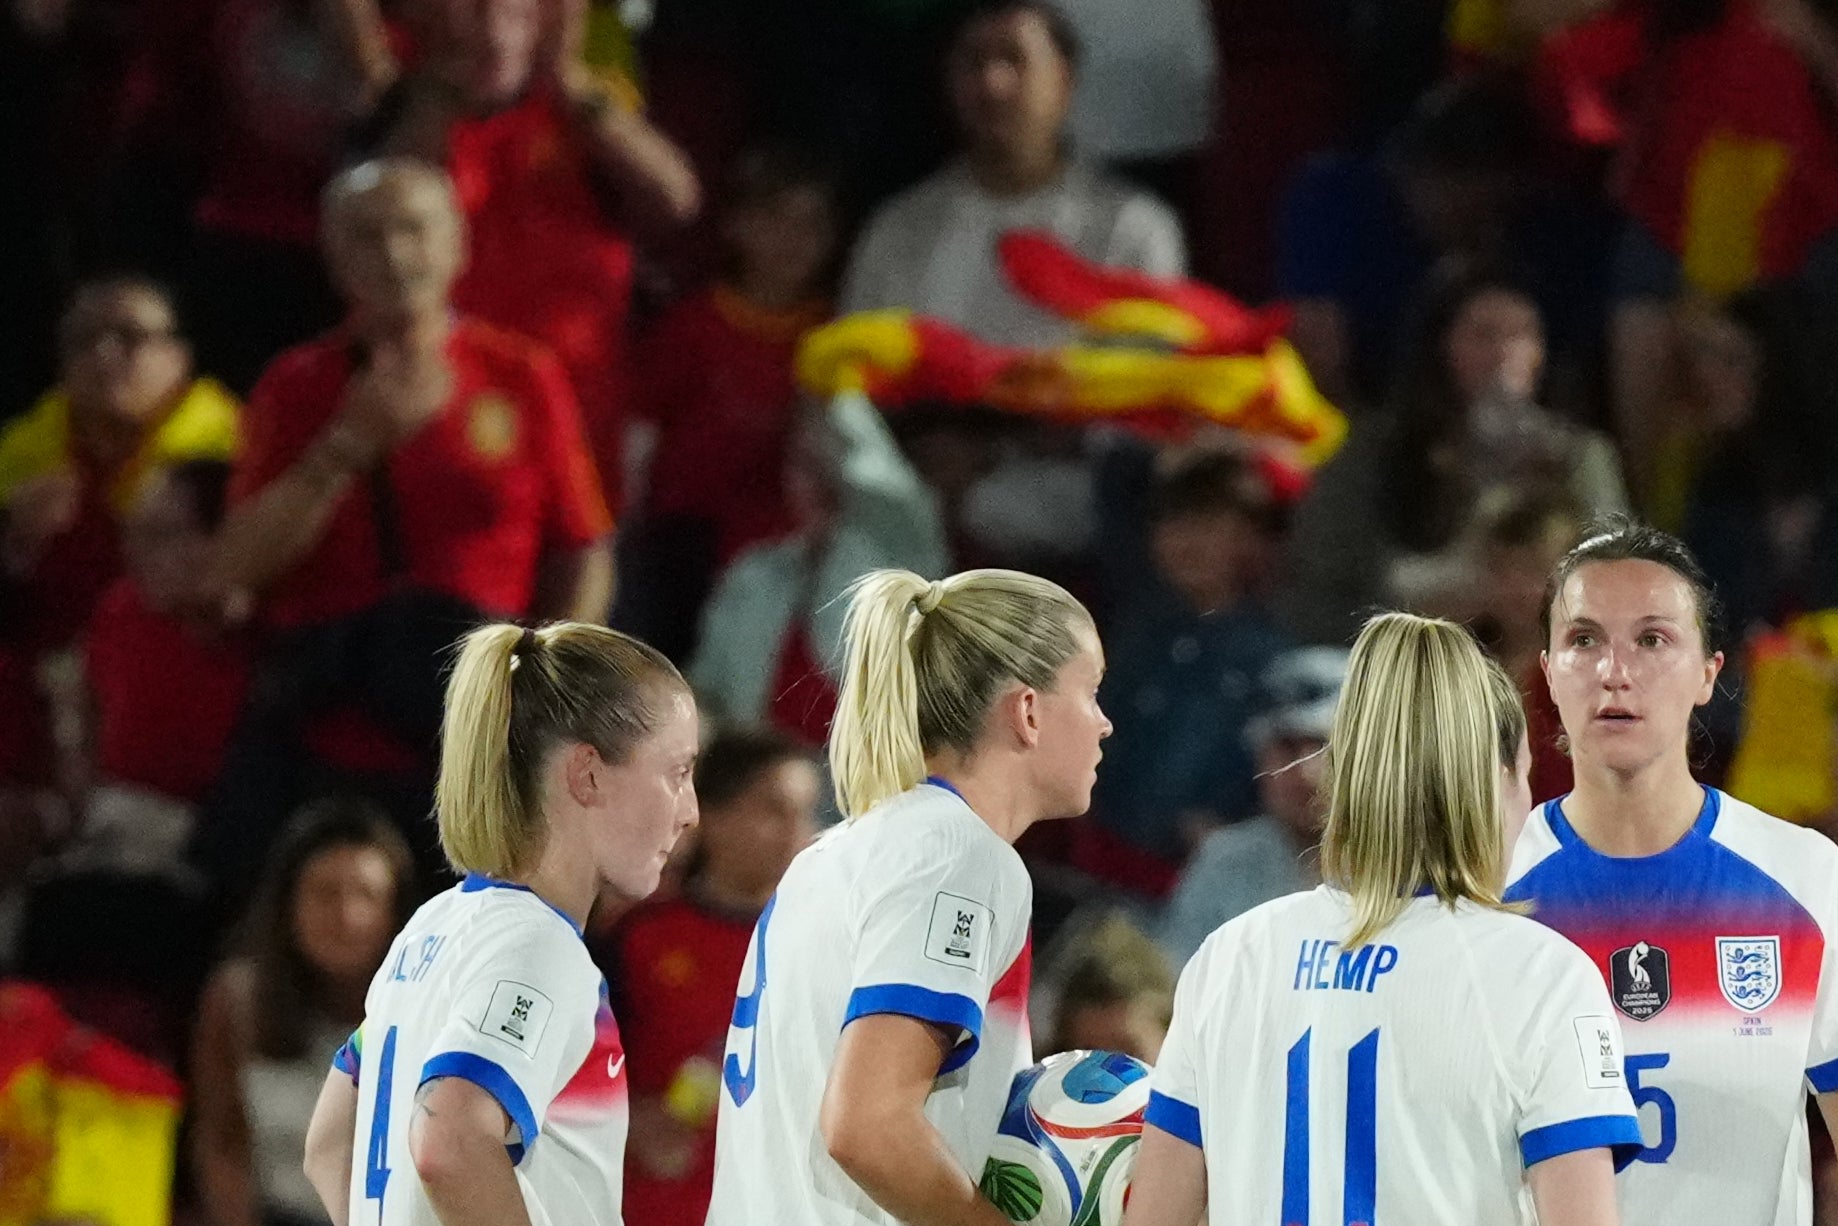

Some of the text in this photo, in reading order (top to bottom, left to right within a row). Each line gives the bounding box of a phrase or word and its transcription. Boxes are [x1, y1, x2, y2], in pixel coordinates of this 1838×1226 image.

[723, 887, 777, 1108] 9
[1293, 939, 1398, 993] HEMP
[1622, 1053, 1677, 1164] 5
